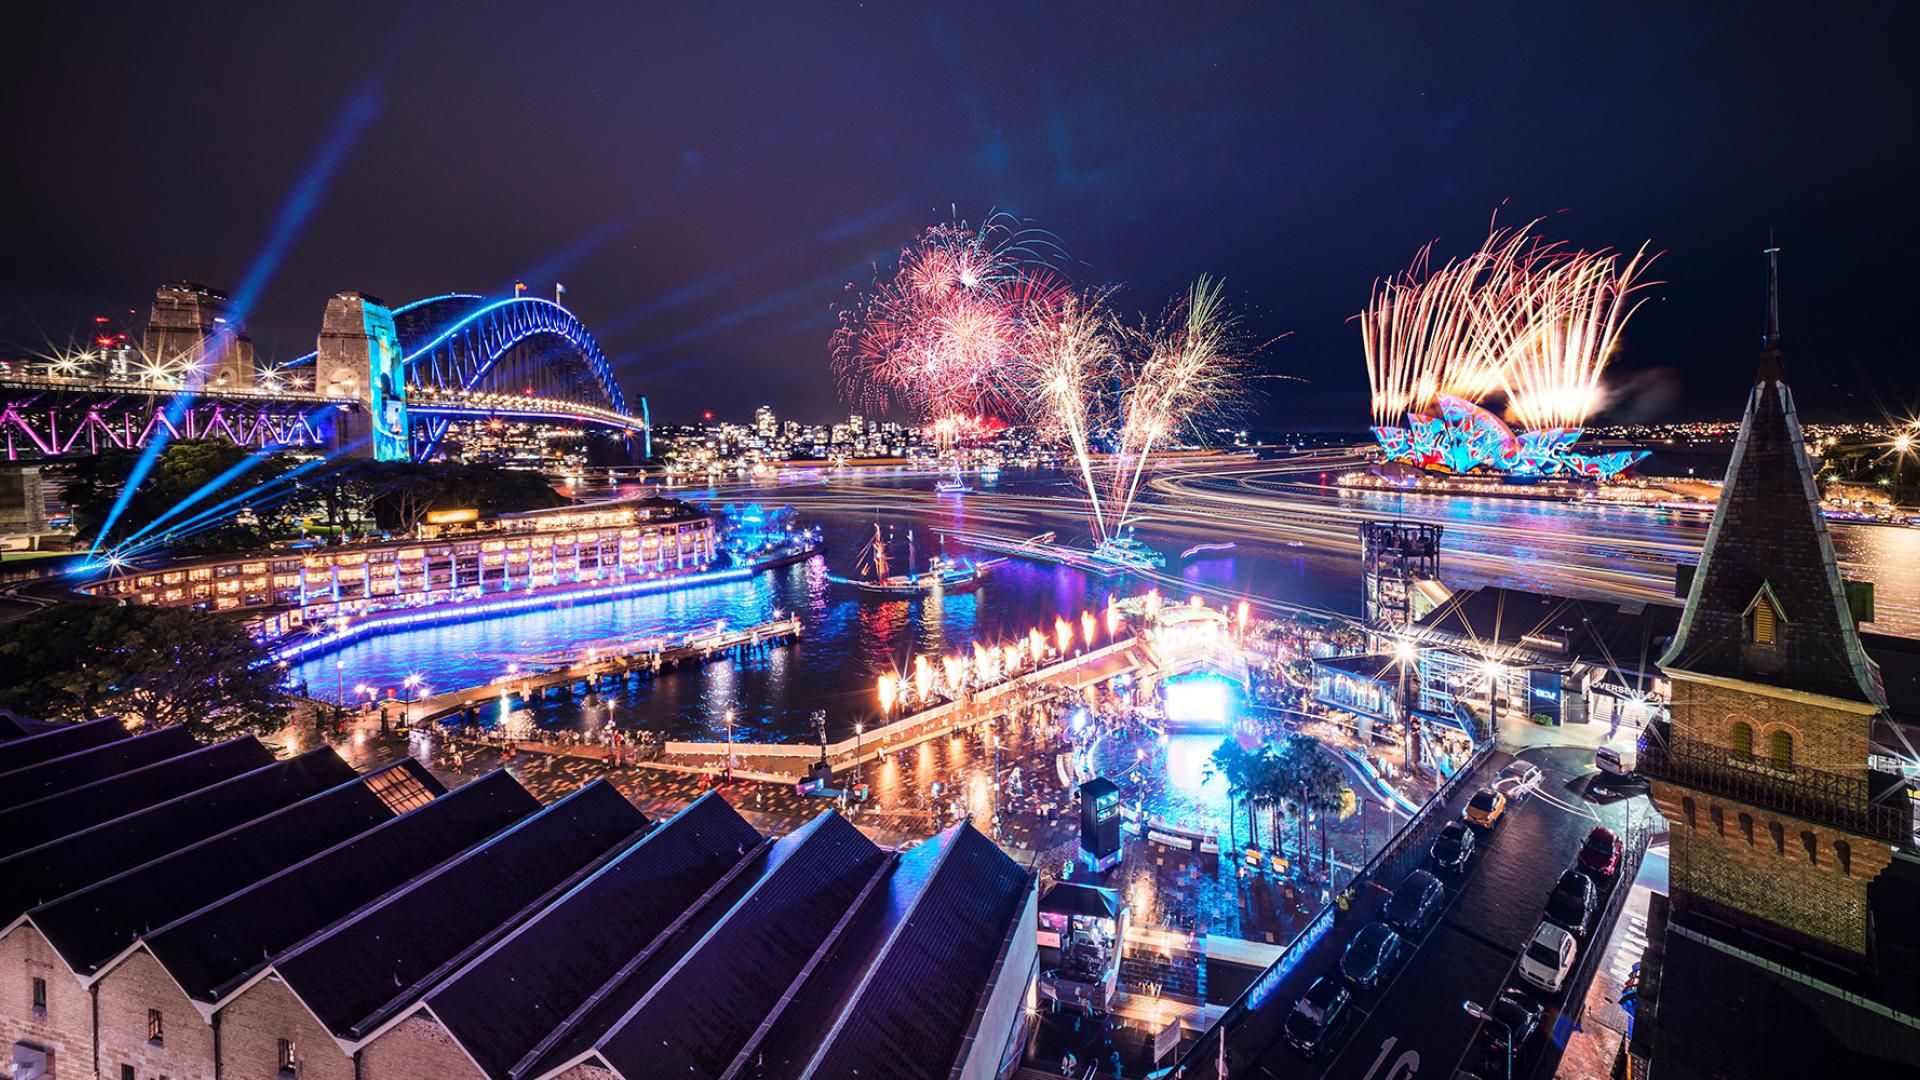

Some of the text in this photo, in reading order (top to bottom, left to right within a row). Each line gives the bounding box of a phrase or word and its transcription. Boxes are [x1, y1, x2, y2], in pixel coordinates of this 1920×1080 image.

[1591, 681, 1645, 699] OVERSEAS
[1251, 909, 1335, 1004] PUBLIC CAR PARK
